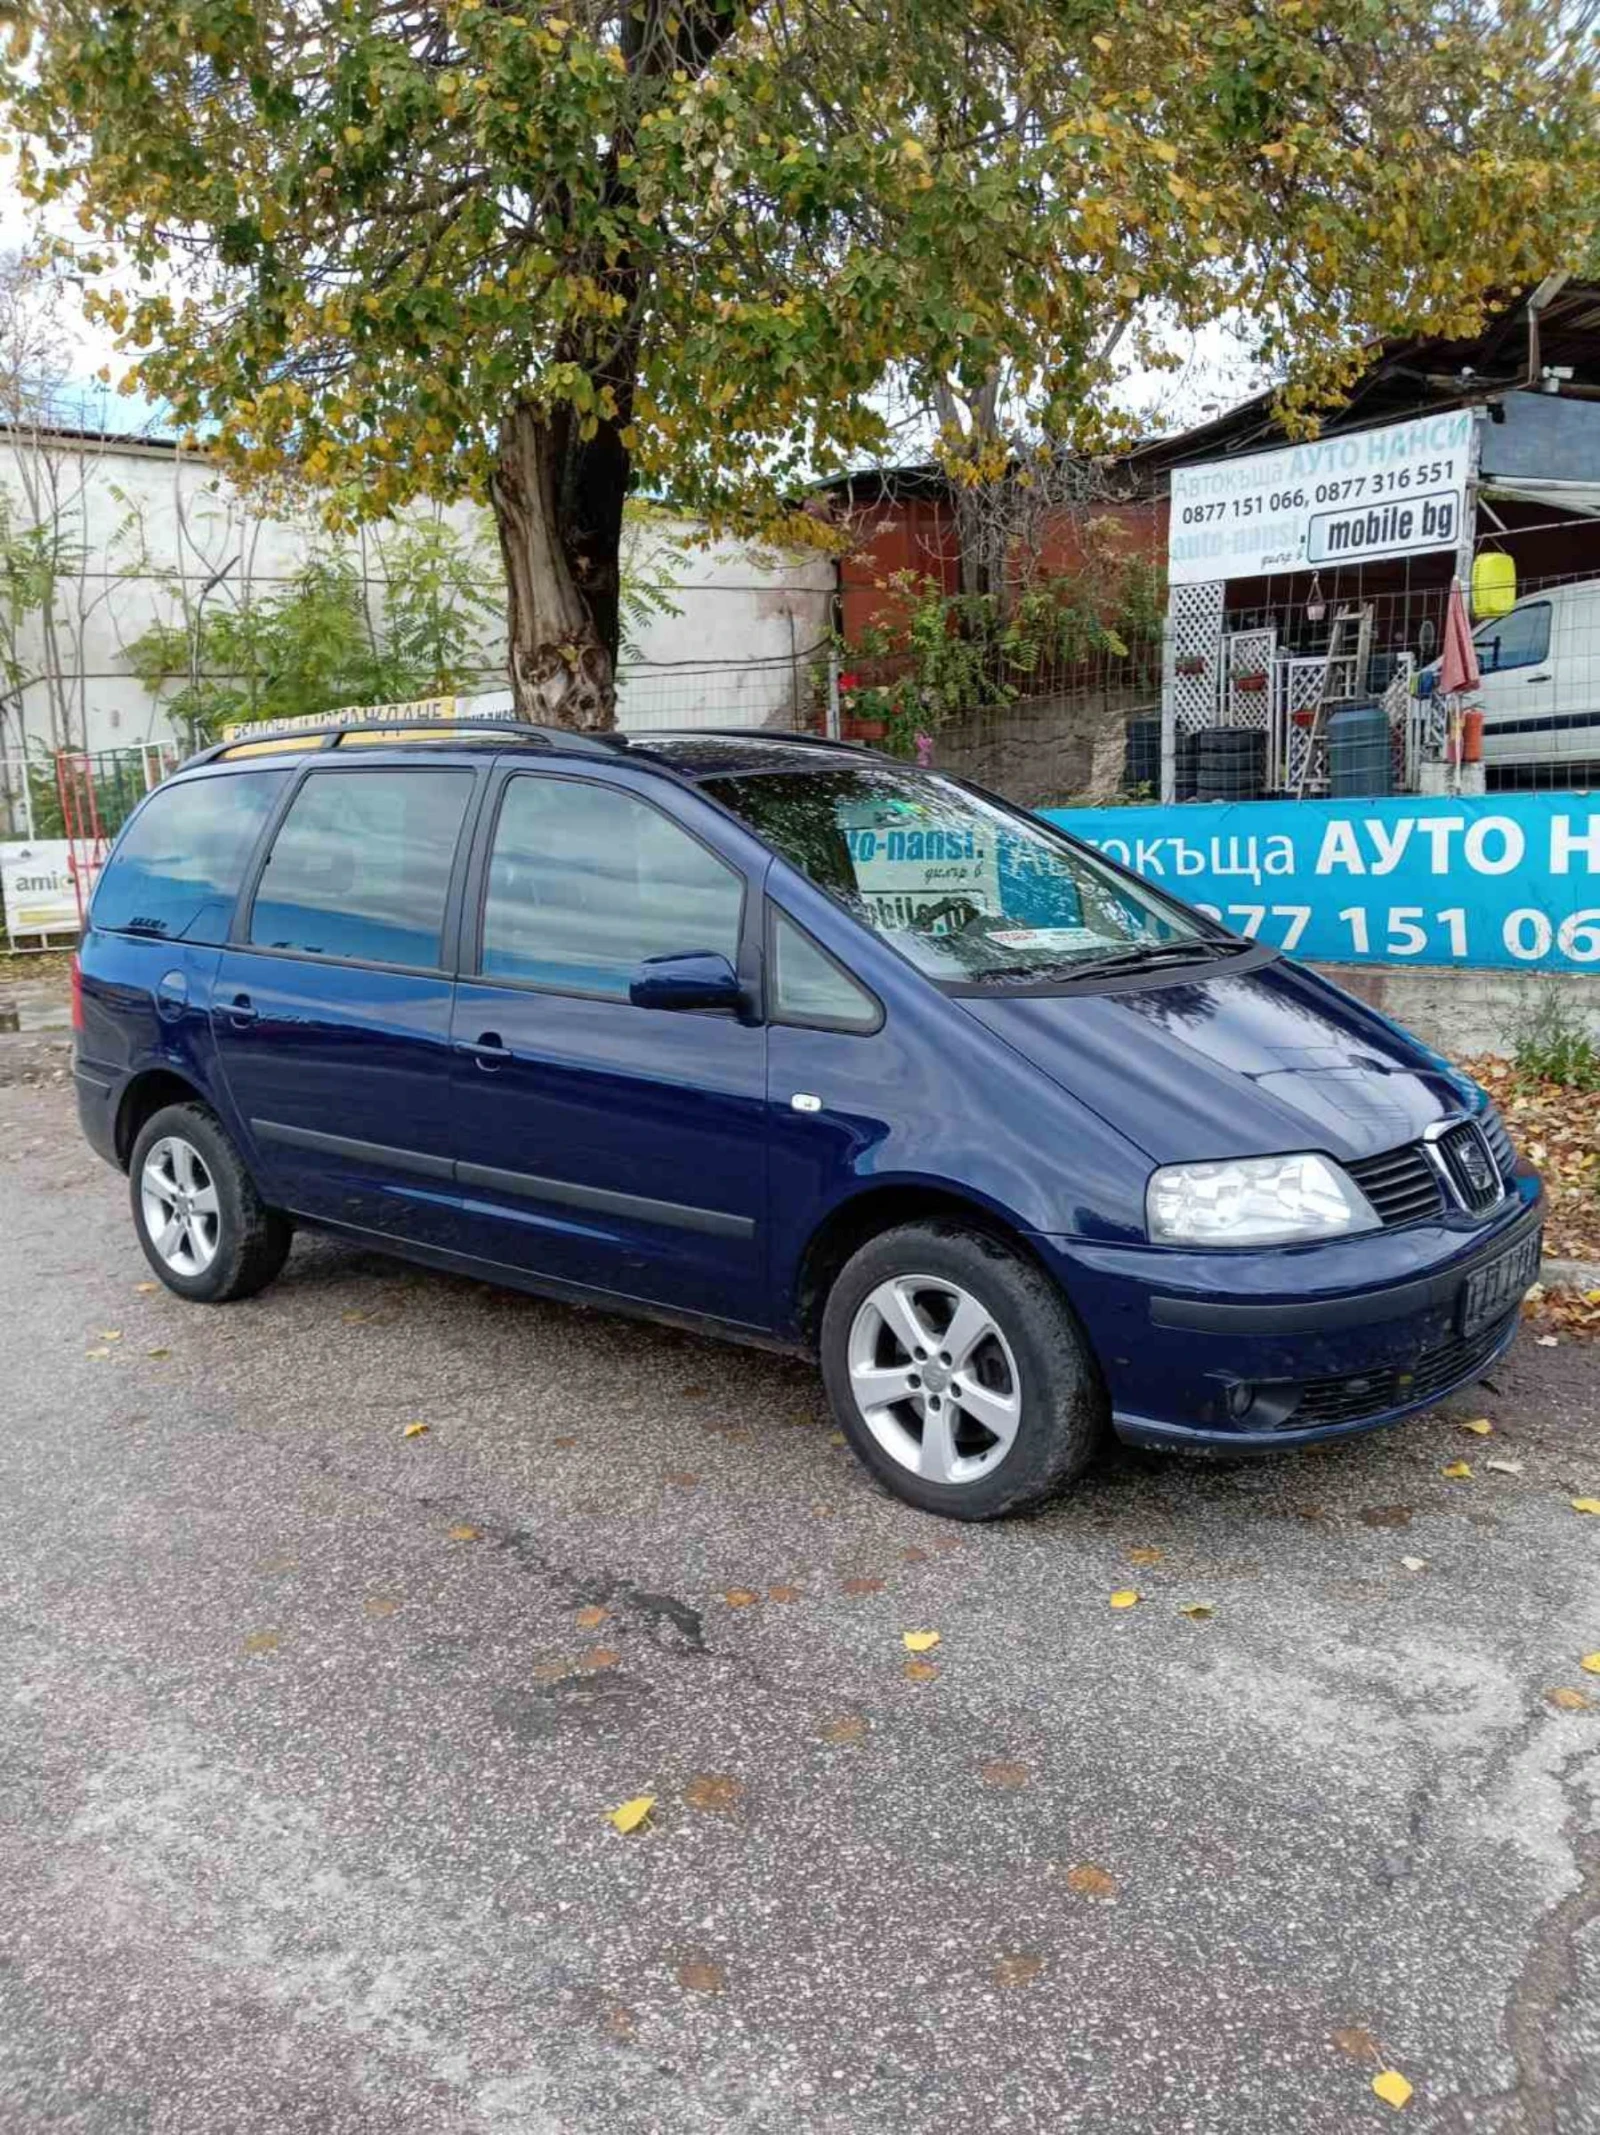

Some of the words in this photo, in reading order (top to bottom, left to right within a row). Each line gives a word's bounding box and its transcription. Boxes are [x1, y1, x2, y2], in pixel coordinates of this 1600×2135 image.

[1288, 438, 1360, 480] АУТО
[1367, 414, 1470, 468] НАНСИ
[1182, 502, 1226, 524] 0877
[1232, 496, 1262, 517] 151
[1269, 488, 1309, 511] 066,
[1315, 477, 1366, 503] 0877
[1372, 467, 1410, 493] 316
[1416, 460, 1453, 485] 551
[1327, 504, 1413, 551] mobile
[1422, 500, 1453, 538] bg
[1314, 816, 1525, 876] АУТО
[1338, 906, 1468, 957] 151
